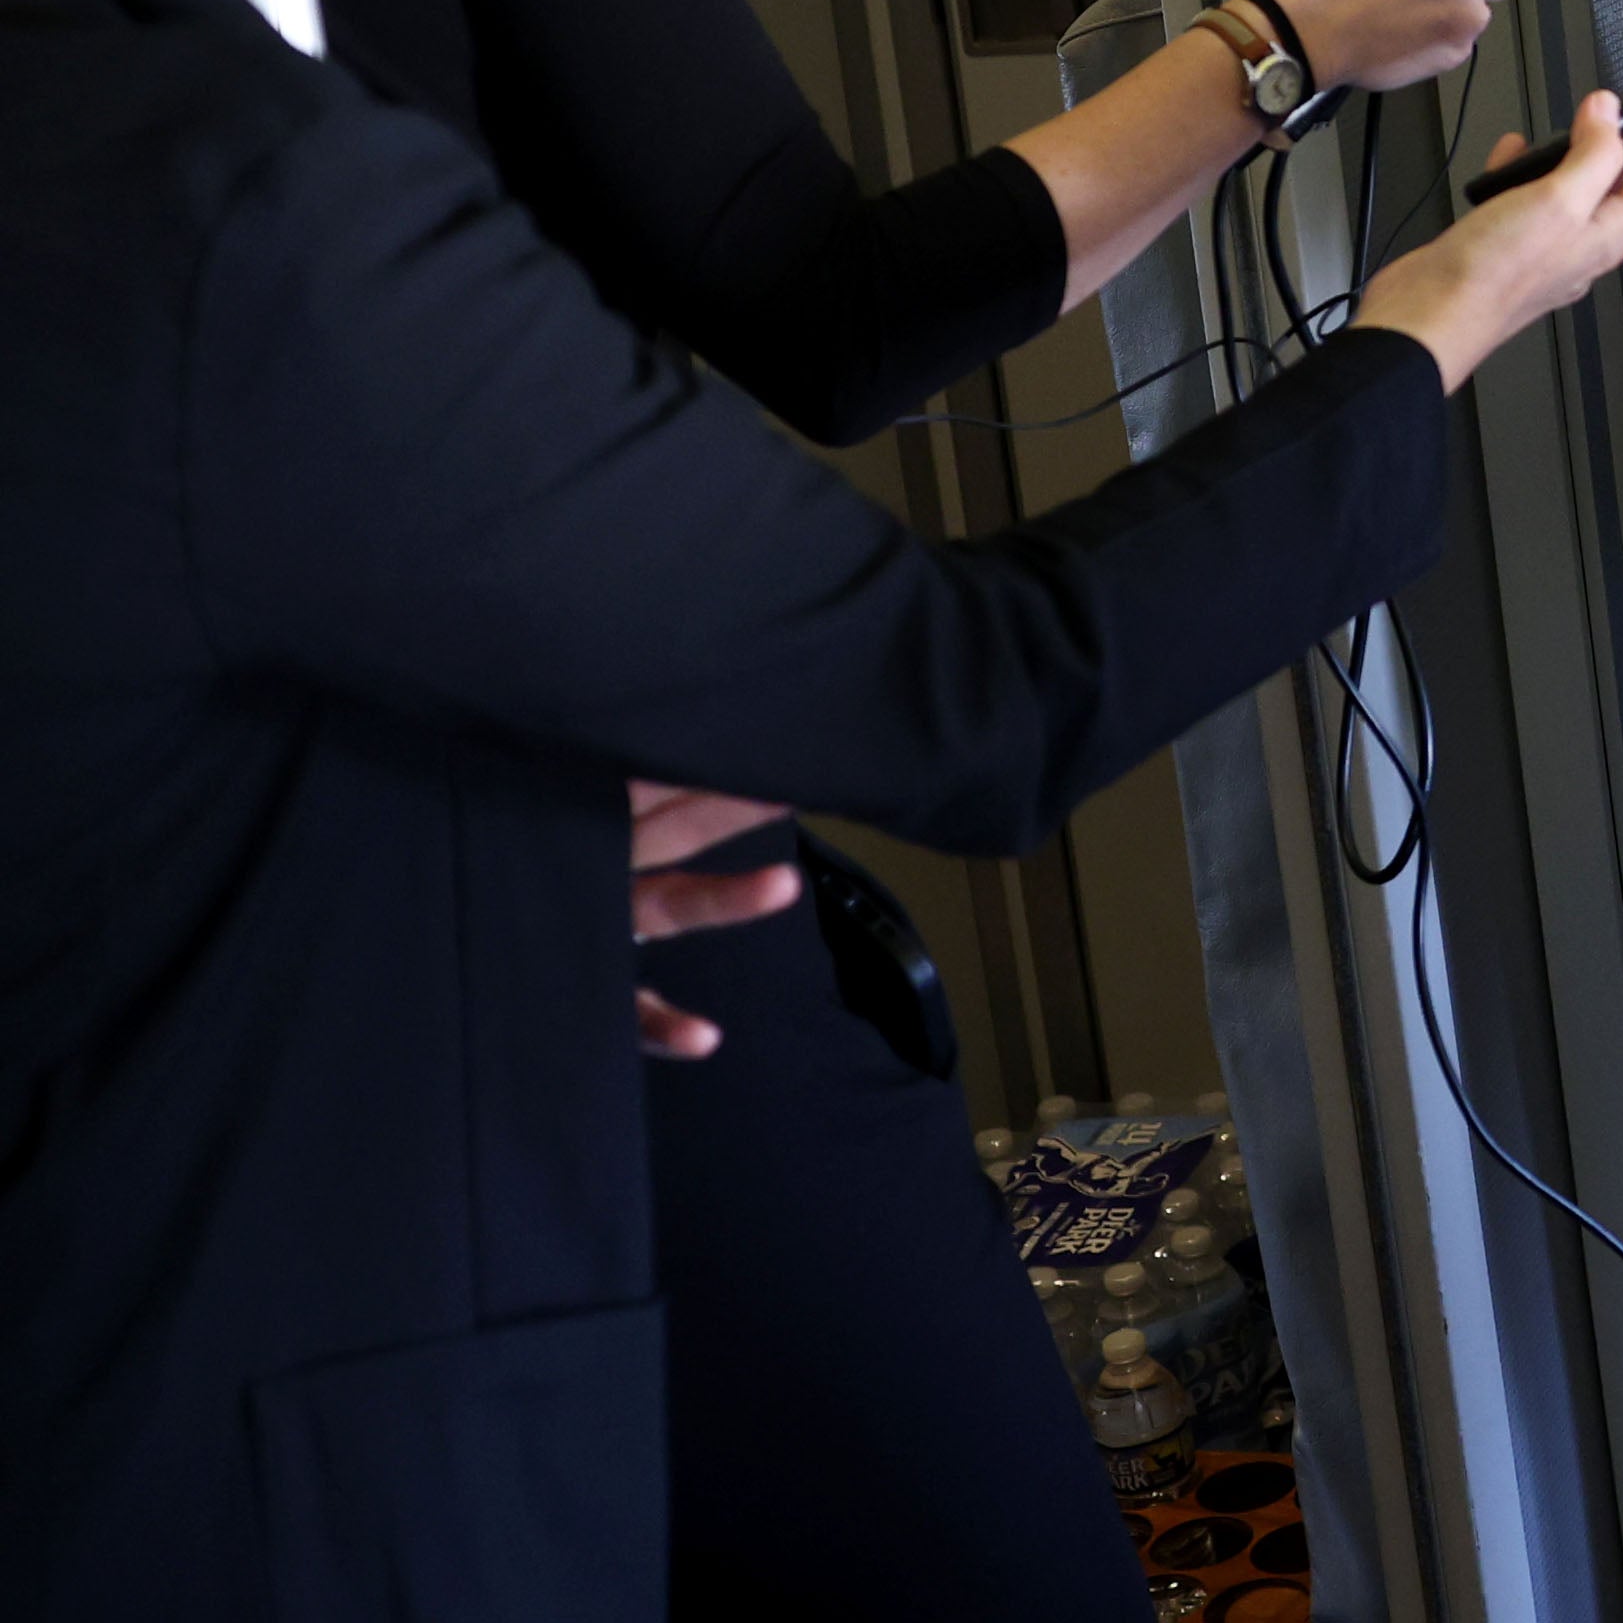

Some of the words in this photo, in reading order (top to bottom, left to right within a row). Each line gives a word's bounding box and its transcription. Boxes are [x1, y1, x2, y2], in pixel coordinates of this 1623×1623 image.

[1048, 1206, 1105, 1256] PARK
[1077, 1206, 1136, 1255] DEER
[1106, 1457, 1145, 1474] EER
[1110, 1473, 1150, 1492] ARK
